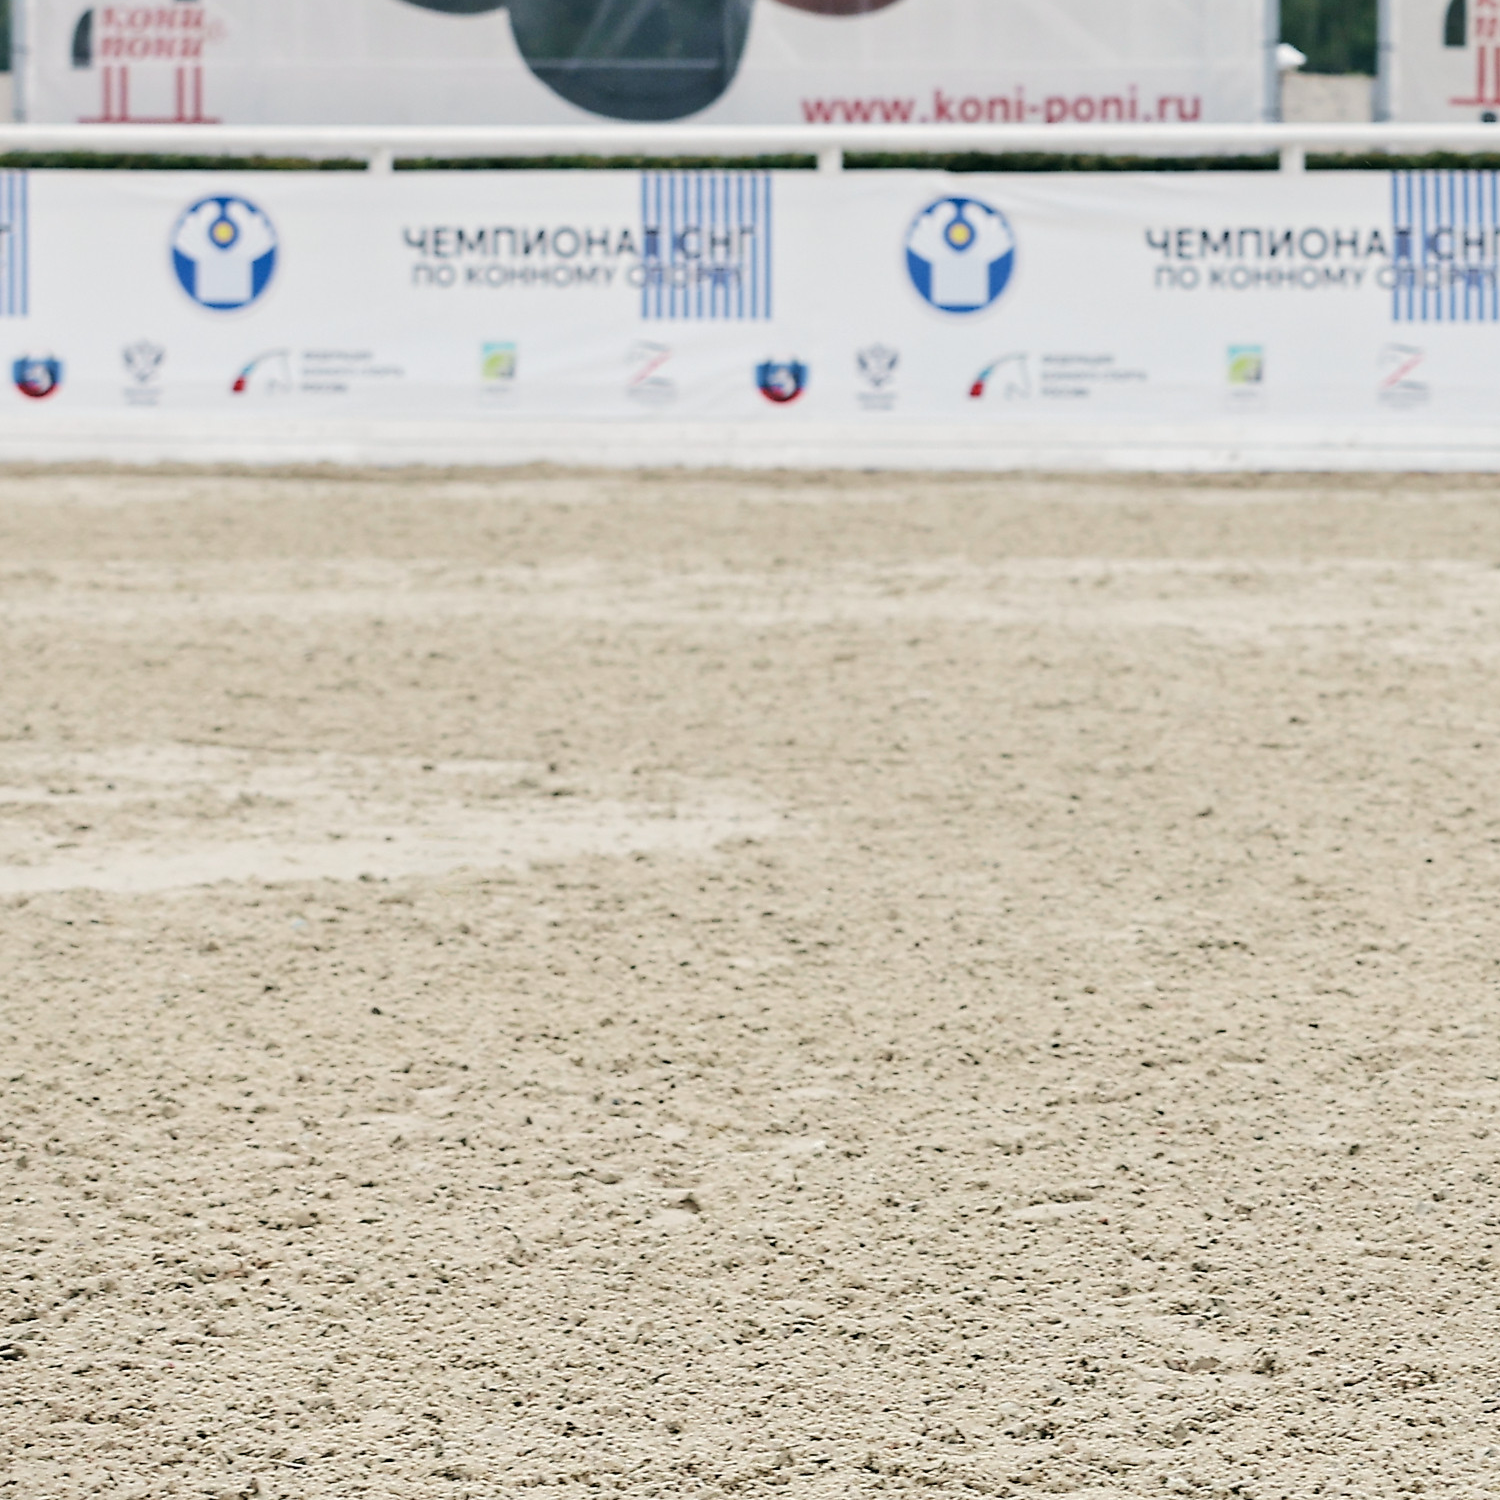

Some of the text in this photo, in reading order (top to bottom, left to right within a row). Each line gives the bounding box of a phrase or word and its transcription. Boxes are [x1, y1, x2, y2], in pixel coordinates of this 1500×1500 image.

[801, 85, 1202, 125] www.koni-poni.ru
[402, 225, 756, 259] ЧЕМПИОНАТ СНГ
[1145, 226, 1412, 261] ЧЕМПИОНАТ
[413, 263, 457, 288] ПО
[466, 263, 617, 288] КОННОМУ
[1155, 264, 1199, 290] ПО
[1209, 264, 1366, 290] КОННОМУ
